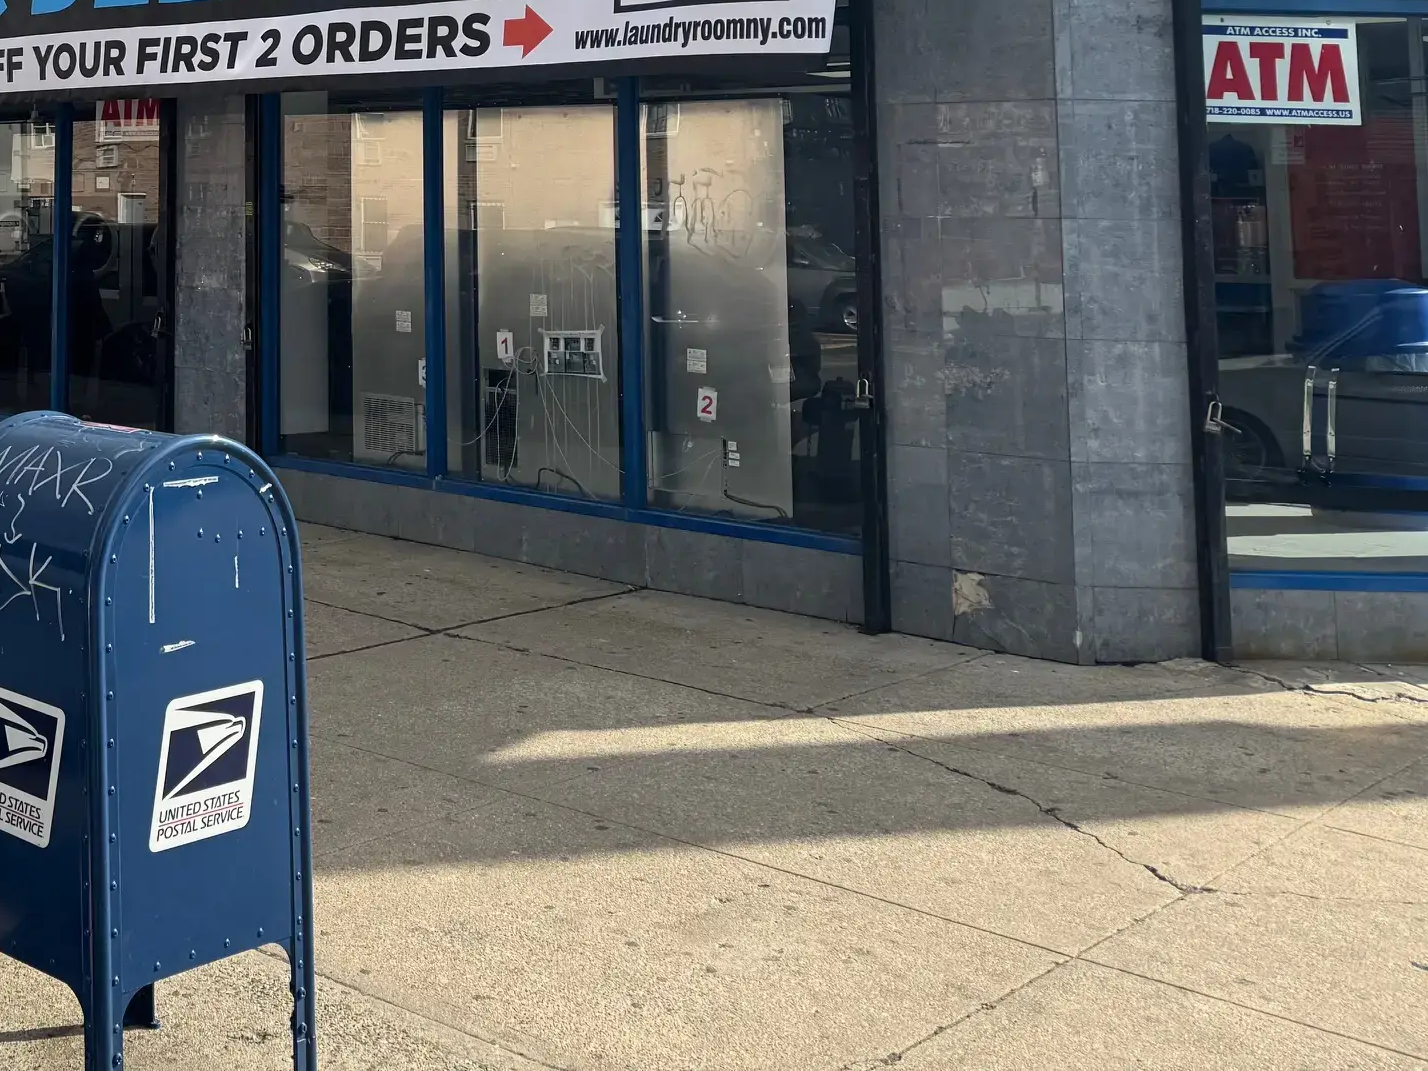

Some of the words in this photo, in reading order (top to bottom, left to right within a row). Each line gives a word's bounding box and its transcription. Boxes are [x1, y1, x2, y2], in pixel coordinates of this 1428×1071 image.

[32, 38, 124, 81] YOUR
[135, 31, 248, 75] FIRST
[255, 28, 279, 70] 2
[292, 11, 492, 64] ORDERS
[575, 16, 827, 49] www.laundryroomny.com
[1226, 27, 1250, 35] ATM
[1254, 28, 1295, 36] ACCESS
[1298, 29, 1322, 37] INC.
[1206, 41, 1350, 103] ATM
[1265, 109, 1350, 118] WWW.ATMACCESS.US
[501, 337, 509, 355] 1
[701, 395, 713, 415] 2
[7, 795, 41, 819] STATES
[159, 804, 201, 824] UNITED
[202, 790, 241, 813] STATES
[5, 811, 44, 839] SERVICE
[156, 820, 198, 842] POSTAL
[200, 806, 243, 830] SERVICE
